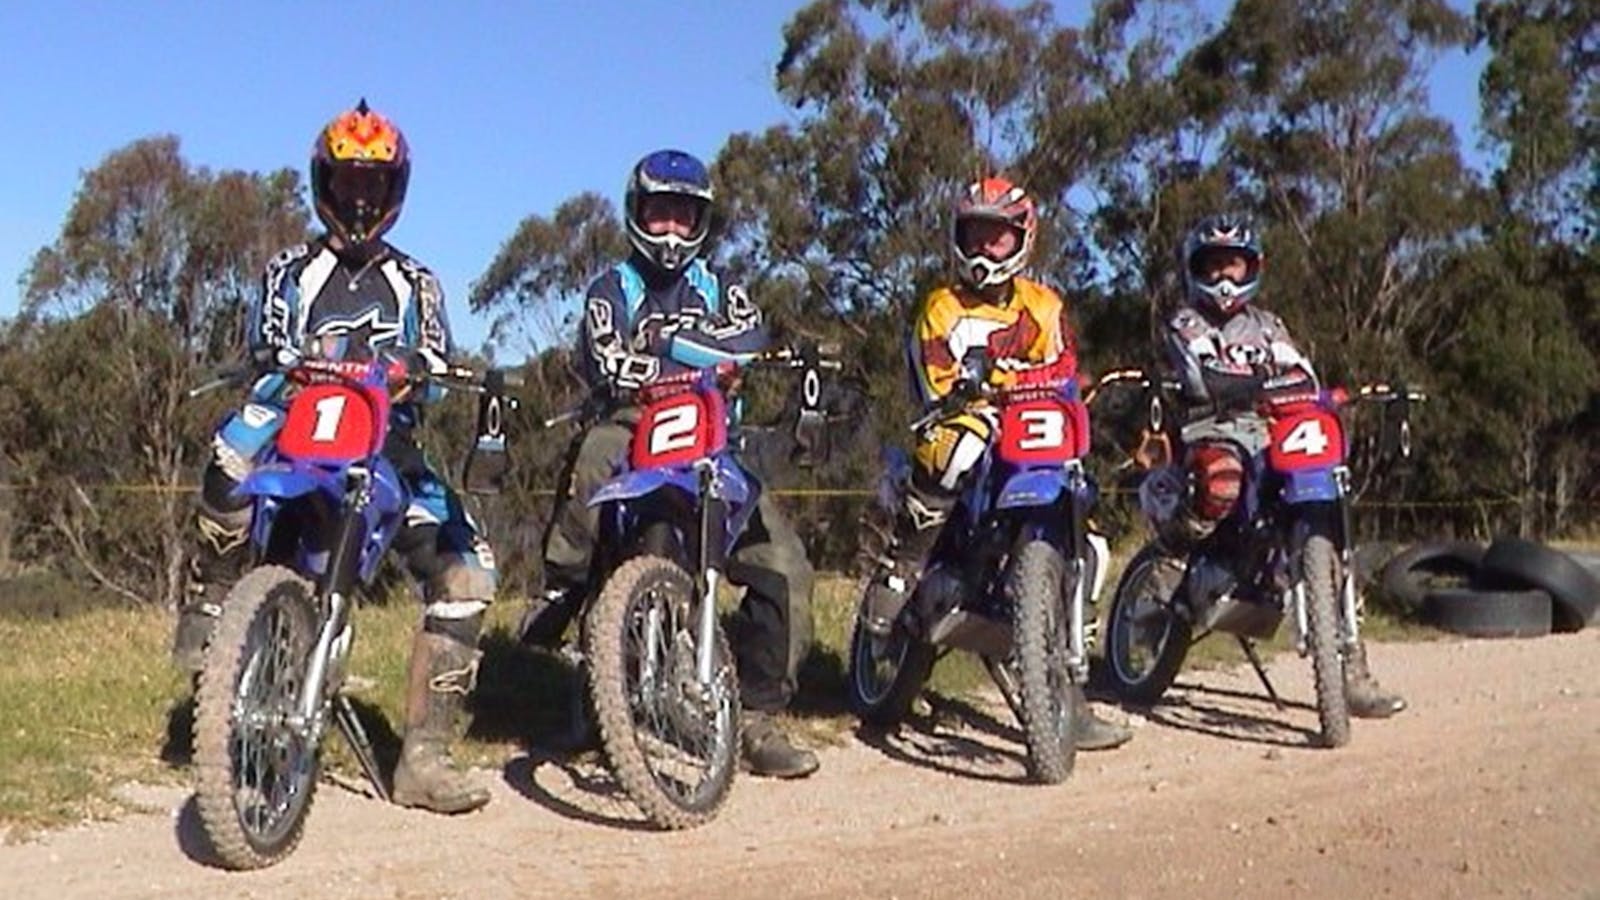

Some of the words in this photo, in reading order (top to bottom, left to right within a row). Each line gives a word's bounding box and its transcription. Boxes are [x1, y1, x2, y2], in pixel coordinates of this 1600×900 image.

[311, 395, 346, 441] 1
[650, 404, 699, 454] 2
[1018, 410, 1066, 450] 3
[1281, 419, 1329, 456] 4
